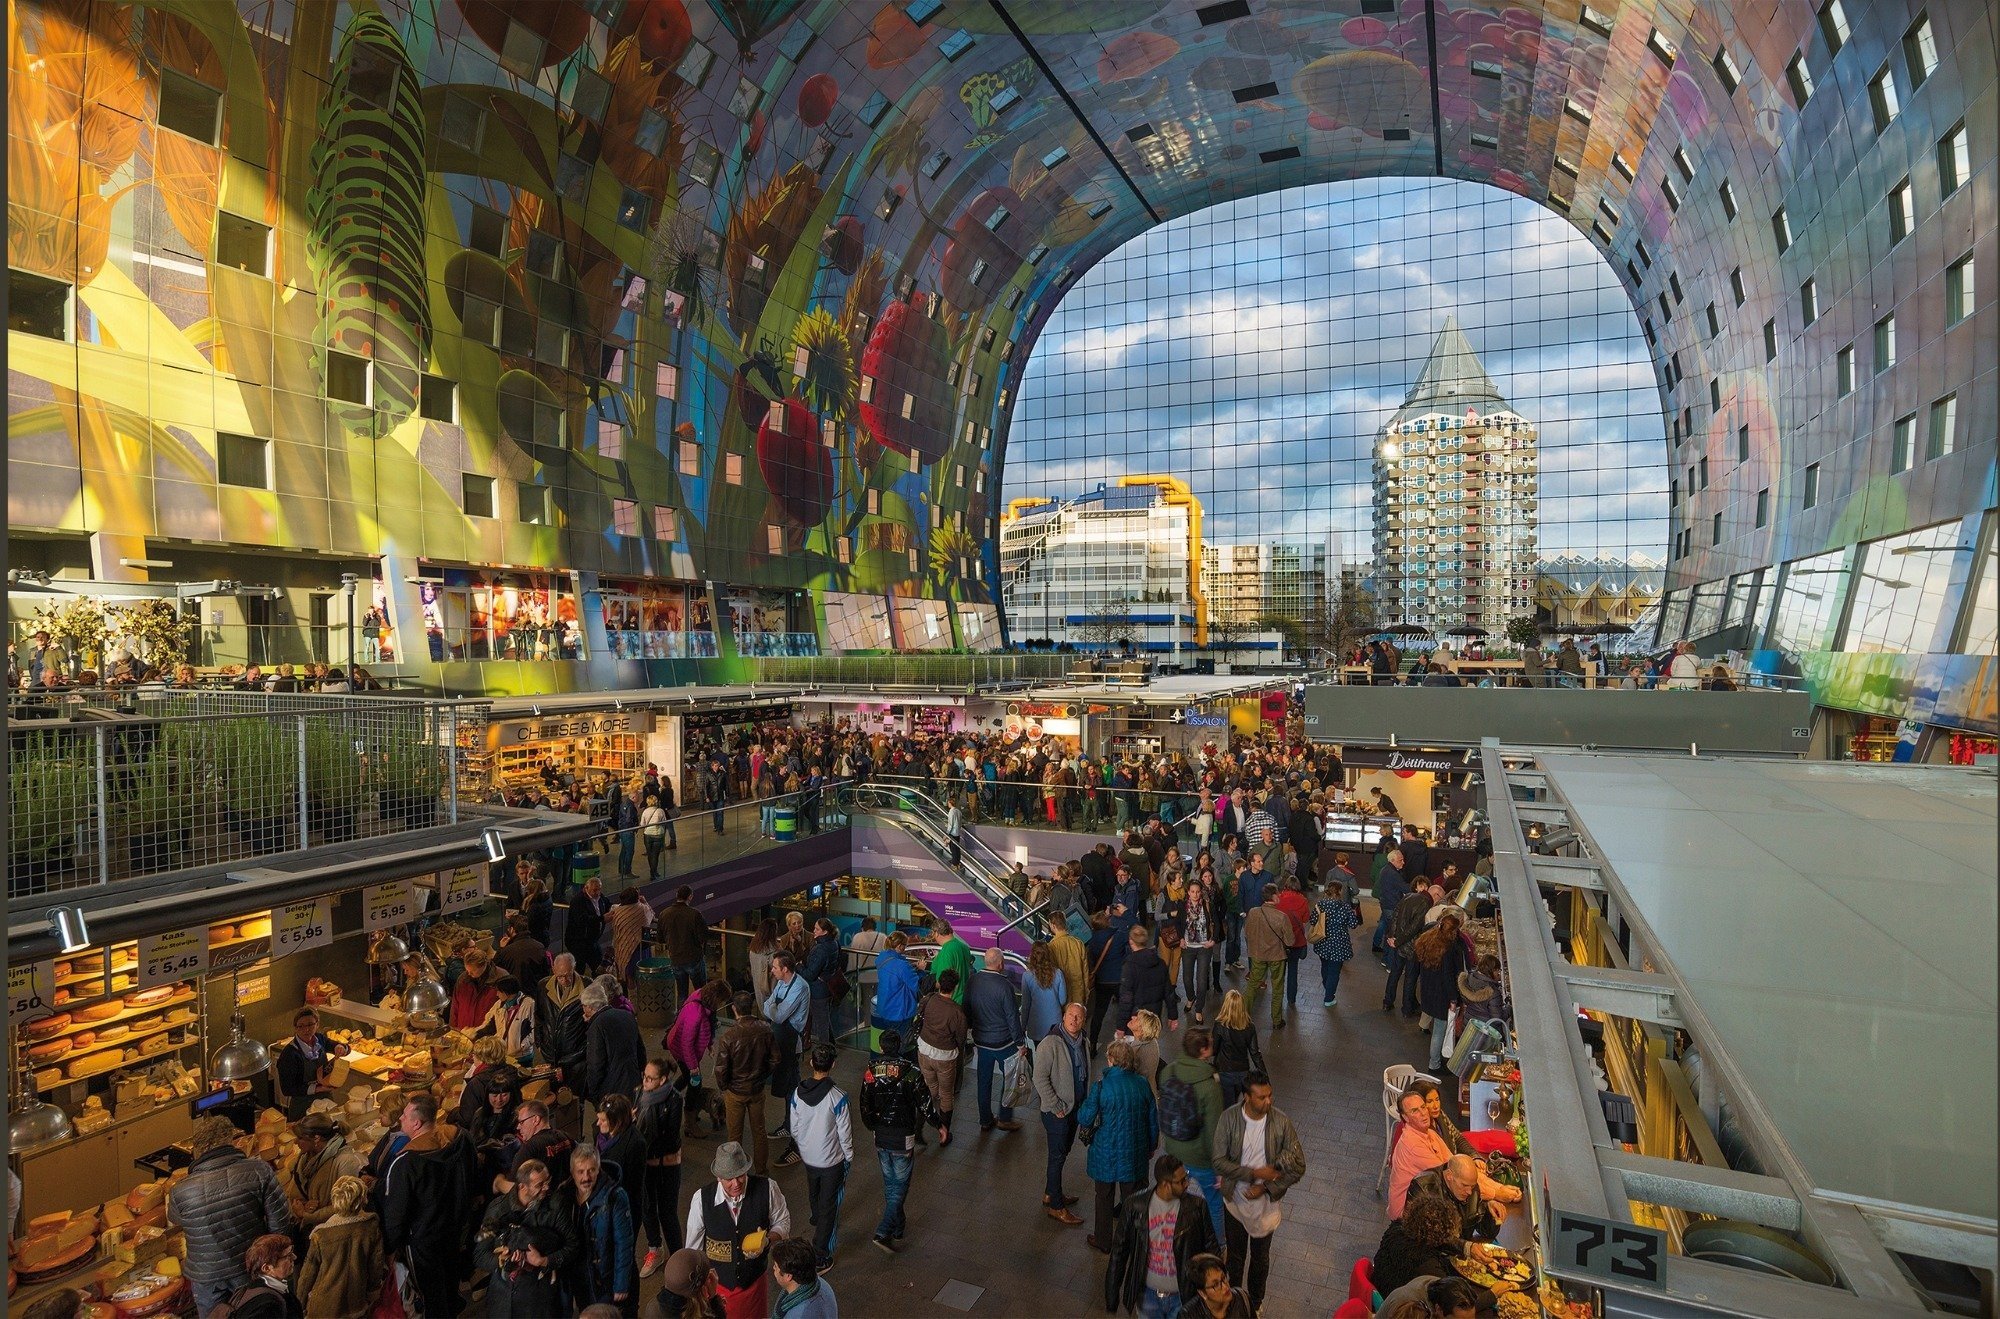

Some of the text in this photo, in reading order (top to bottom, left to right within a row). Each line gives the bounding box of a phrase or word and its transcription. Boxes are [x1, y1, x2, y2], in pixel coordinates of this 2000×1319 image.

[517, 717, 630, 740] CHEESE & MORE
[1792, 728, 1810, 737] 79
[1386, 751, 1451, 770] Délifrance
[591, 803, 609, 818] 48
[380, 883, 398, 892] Kaas
[456, 889, 478, 903] 5,95
[294, 912, 310, 920] 30+
[370, 904, 406, 921] € 5,95
[161, 931, 186, 942] Kaas
[280, 926, 323, 944] € 5,95
[147, 955, 199, 976] € 5,45
[1560, 1217, 1658, 1283] 73
